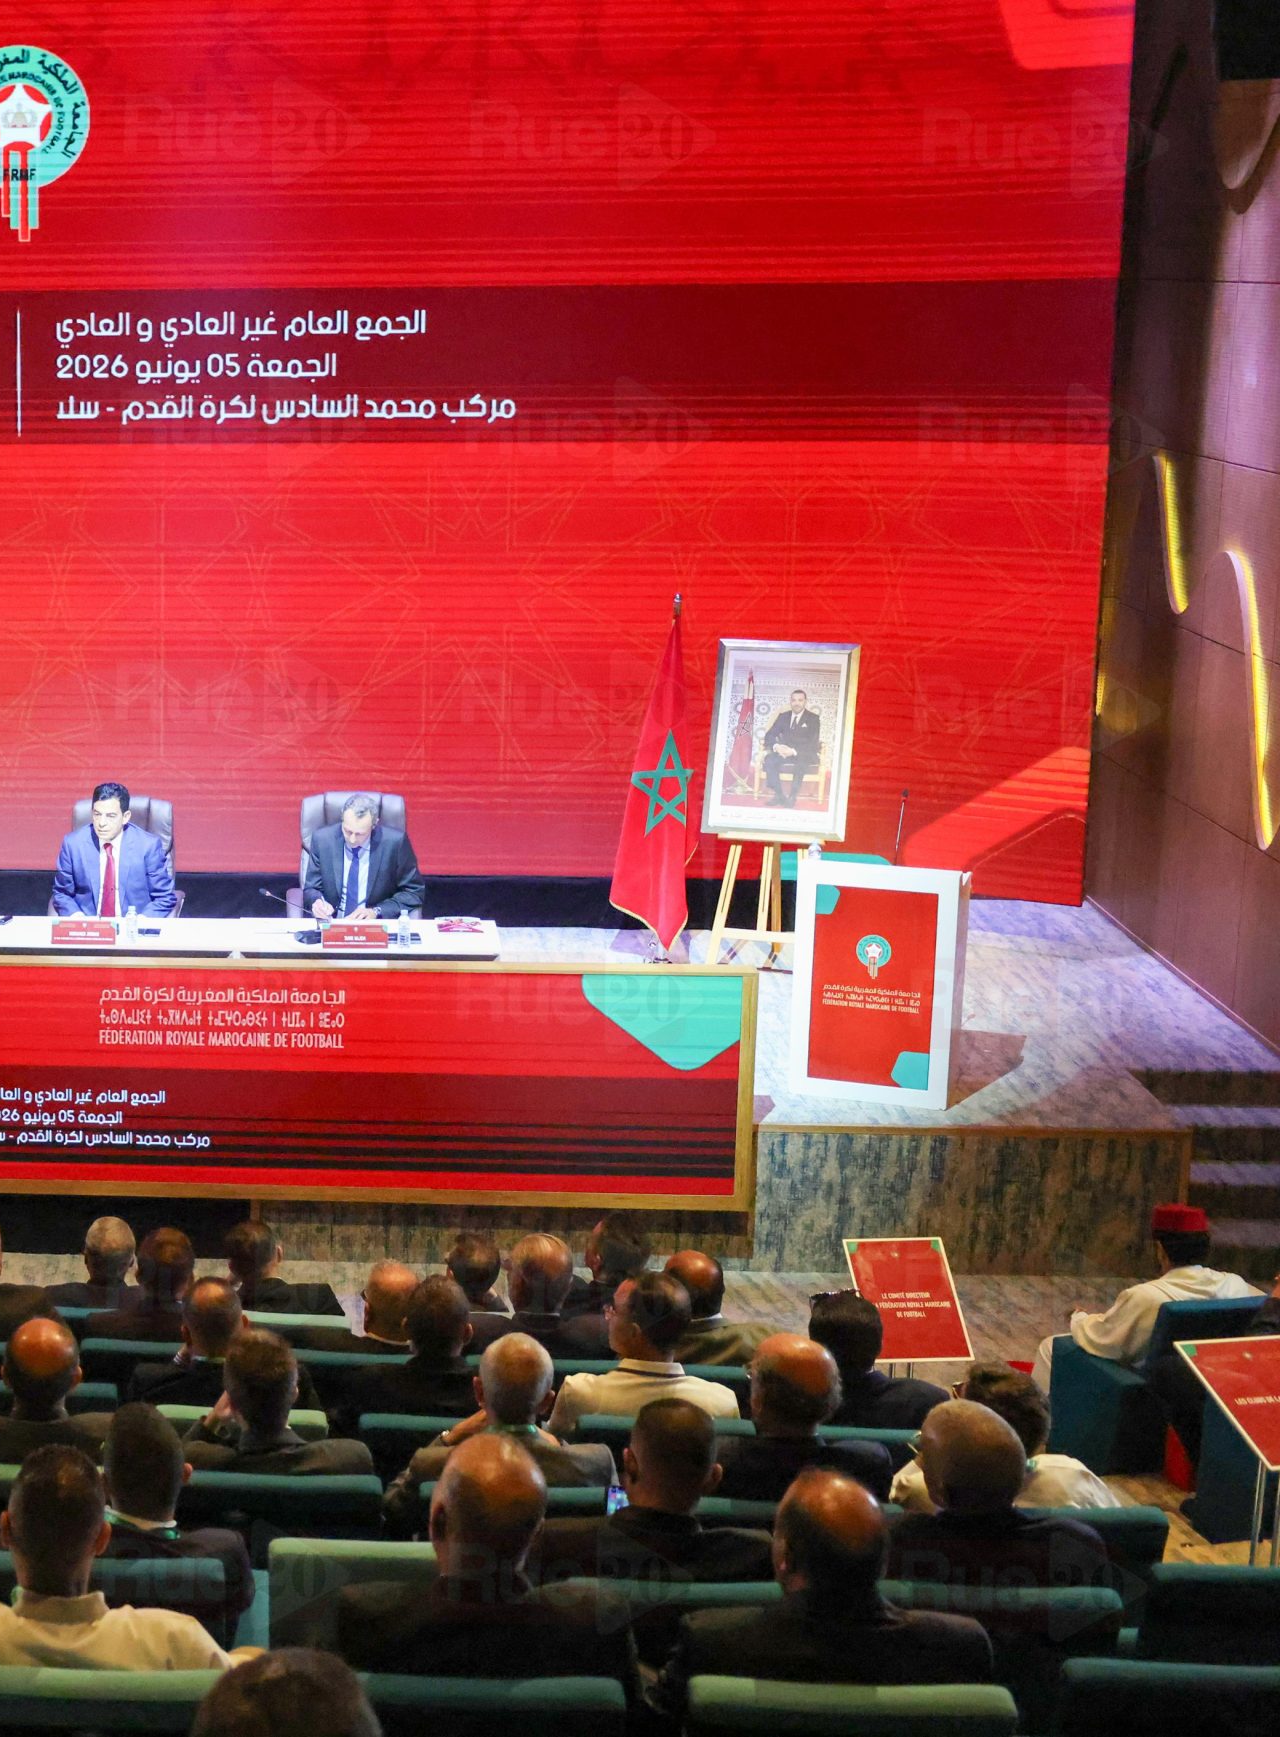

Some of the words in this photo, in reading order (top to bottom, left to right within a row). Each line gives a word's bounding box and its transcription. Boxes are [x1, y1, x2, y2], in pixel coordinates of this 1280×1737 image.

[57, 312, 130, 348] العادي
[137, 318, 152, 342] و
[161, 311, 234, 347] العادي
[241, 311, 277, 341] غير
[284, 310, 348, 341] العام
[355, 310, 426, 340] الجمع
[57, 355, 128, 378] 2026
[136, 354, 200, 384] يونيو
[207, 354, 240, 377] 05
[247, 353, 336, 382] الجمعة
[122, 395, 193, 425] القدم
[200, 395, 256, 424] لكرة
[262, 394, 358, 424] السادس
[365, 400, 436, 419] محمد
[443, 394, 516, 423] مركب
[100, 1027, 162, 1045] FÉDÉRATION
[166, 1031, 205, 1046] ROYALE
[208, 1032, 270, 1047] MAROCAINE
[274, 1033, 288, 1047] DE
[291, 1033, 344, 1048] FOOTBALL
[24, 1091, 32, 1103] و
[35, 1088, 72, 1106] العادي
[75, 1089, 92, 1104] غير
[96, 1090, 127, 1105] العام
[131, 1091, 165, 1106] الجمع
[23, 1110, 55, 1125] يونيو
[59, 1110, 74, 1122] 05
[78, 1111, 122, 1126] الجمعة
[17, 1130, 52, 1144] القدم
[55, 1130, 82, 1145] لكرة
[86, 1132, 132, 1146] السادس
[136, 1135, 170, 1146] محمد
[174, 1133, 210, 1148] مركب
